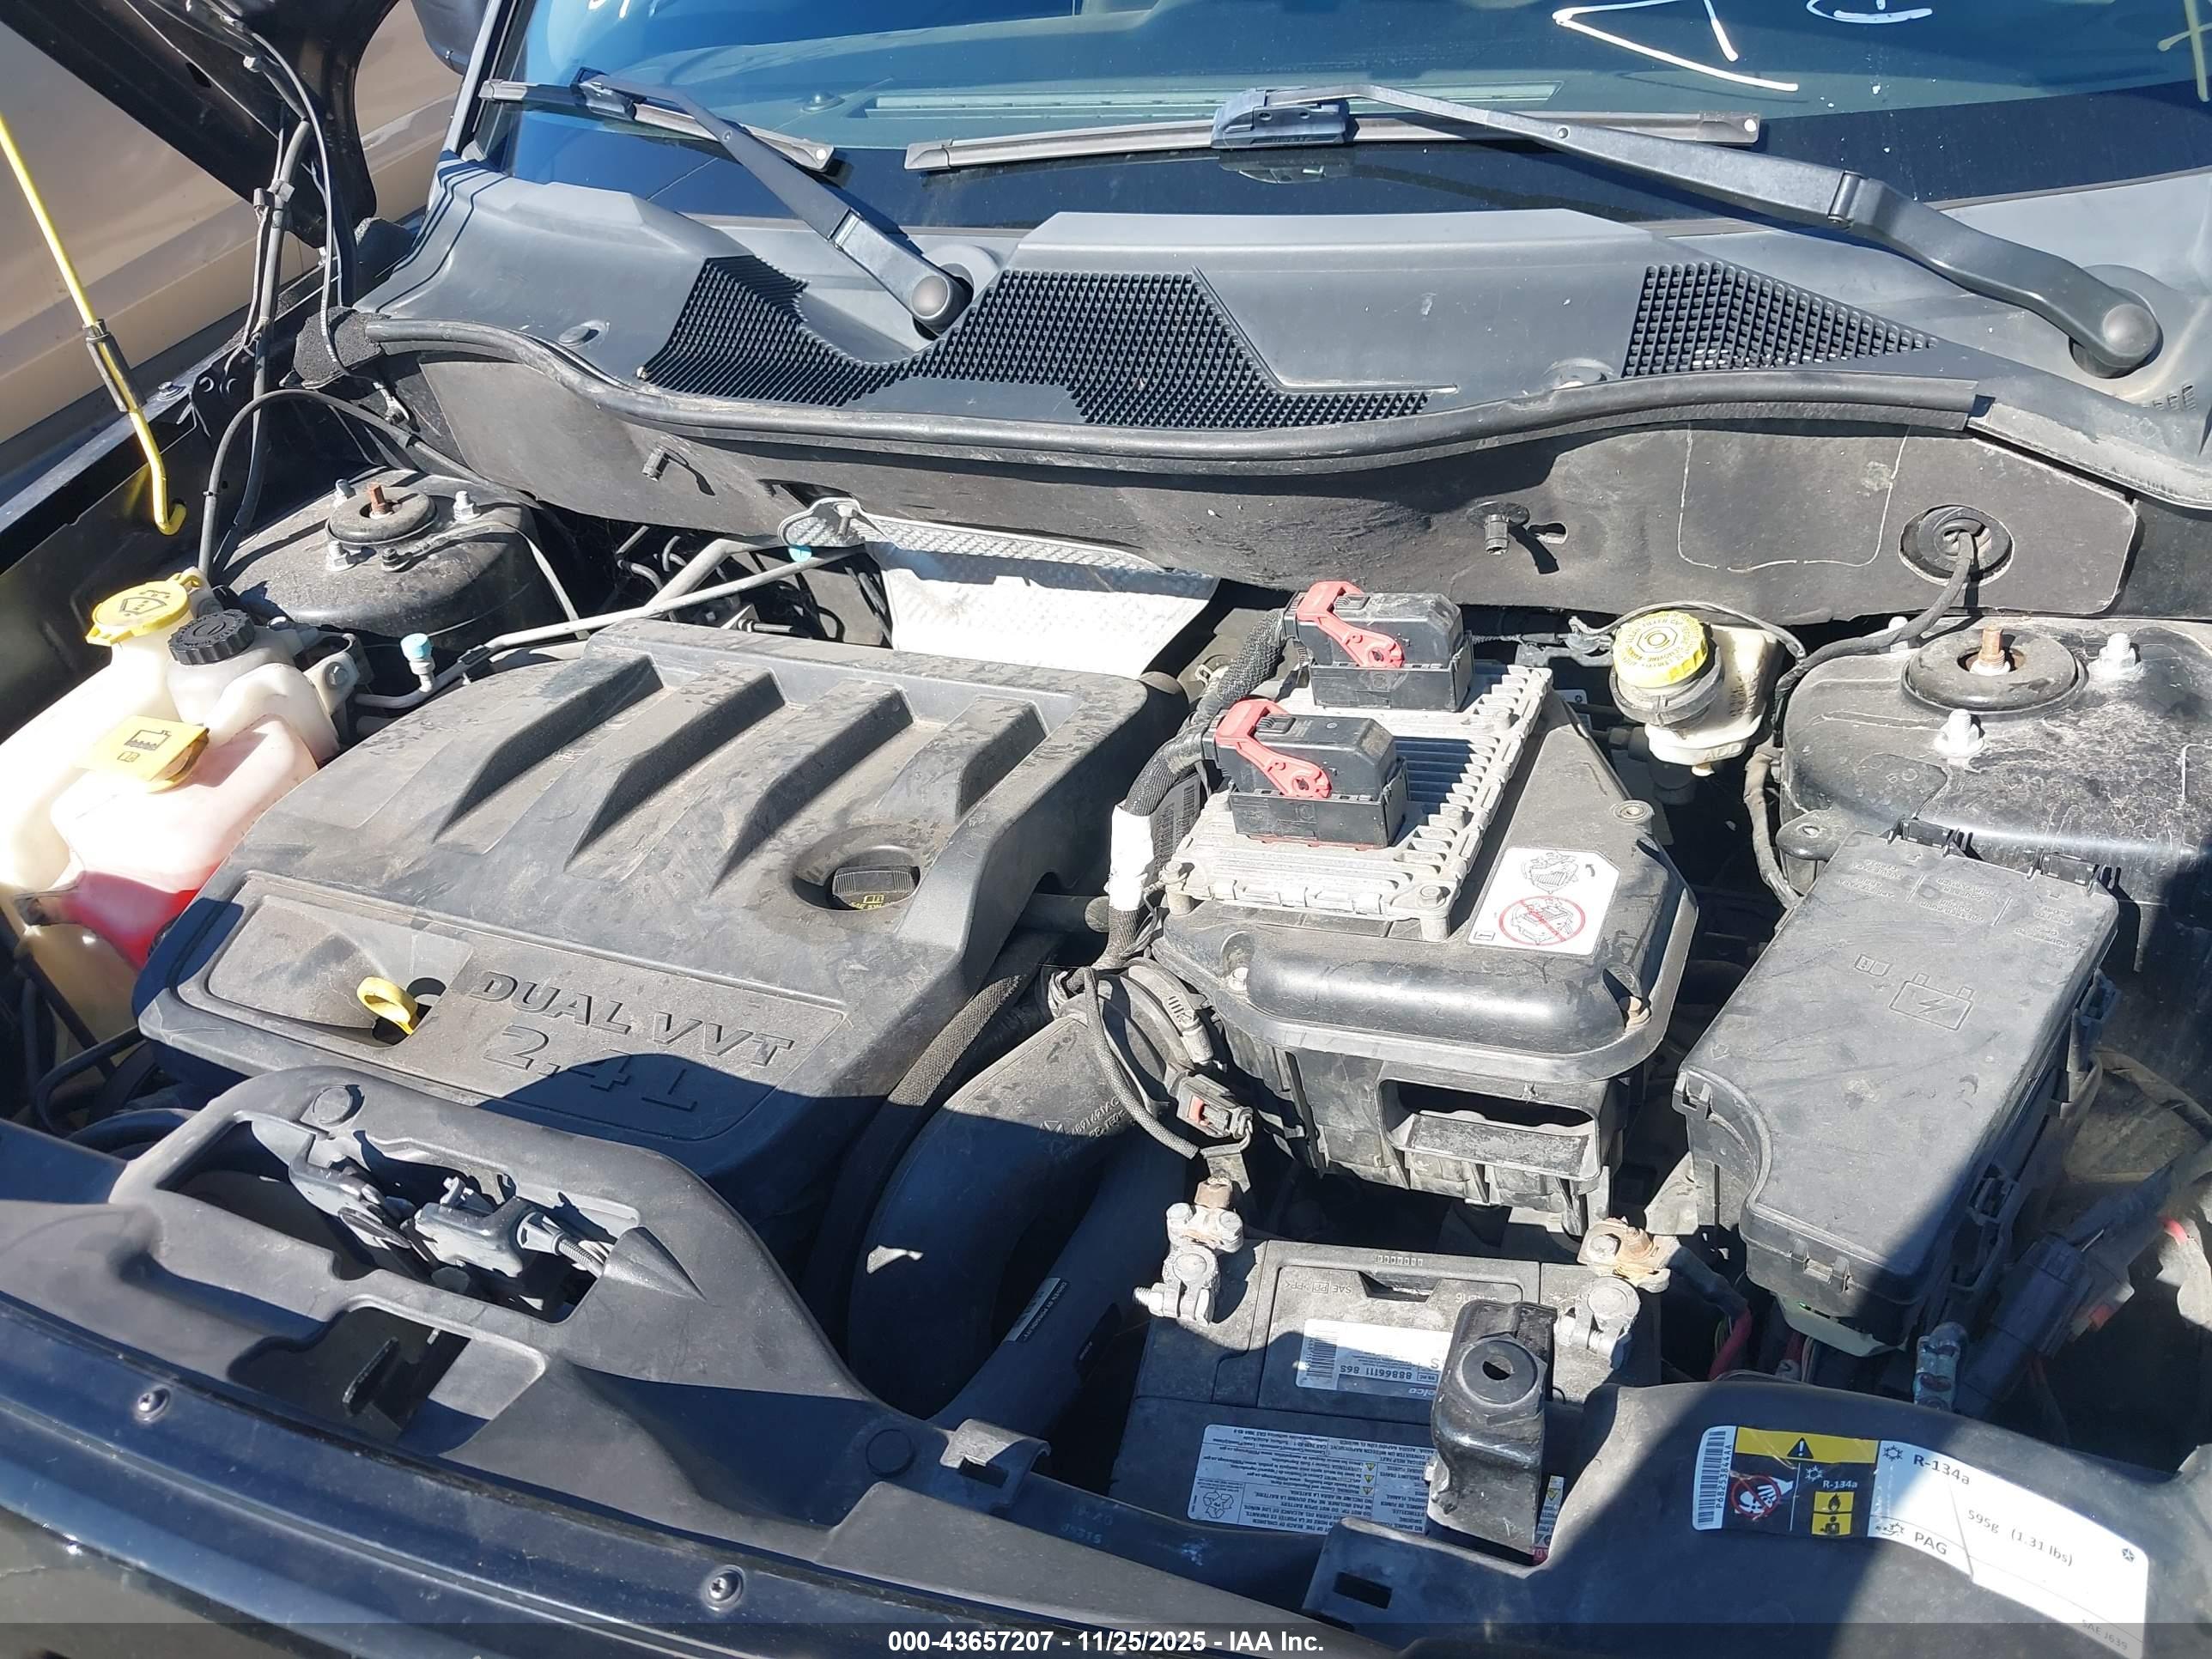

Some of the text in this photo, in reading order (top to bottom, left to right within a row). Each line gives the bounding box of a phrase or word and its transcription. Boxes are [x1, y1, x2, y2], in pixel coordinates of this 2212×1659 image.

[1703, 742, 1741, 761] ADD
[469, 970, 795, 1066] DUAL VVT
[1333, 1284, 1351, 1294] SAE
[1340, 1364, 1412, 1379] 88866111 86S
[1715, 1443, 1733, 1509] P68253844AA
[1912, 1453, 1970, 1484] R-134a
[1822, 1479, 1857, 1488] R-134a
[1913, 1530, 1947, 1554] PAG
[1966, 1509, 2074, 1566] 595g (1.31 lbs)
[2081, 1619, 2100, 1636] SAE
